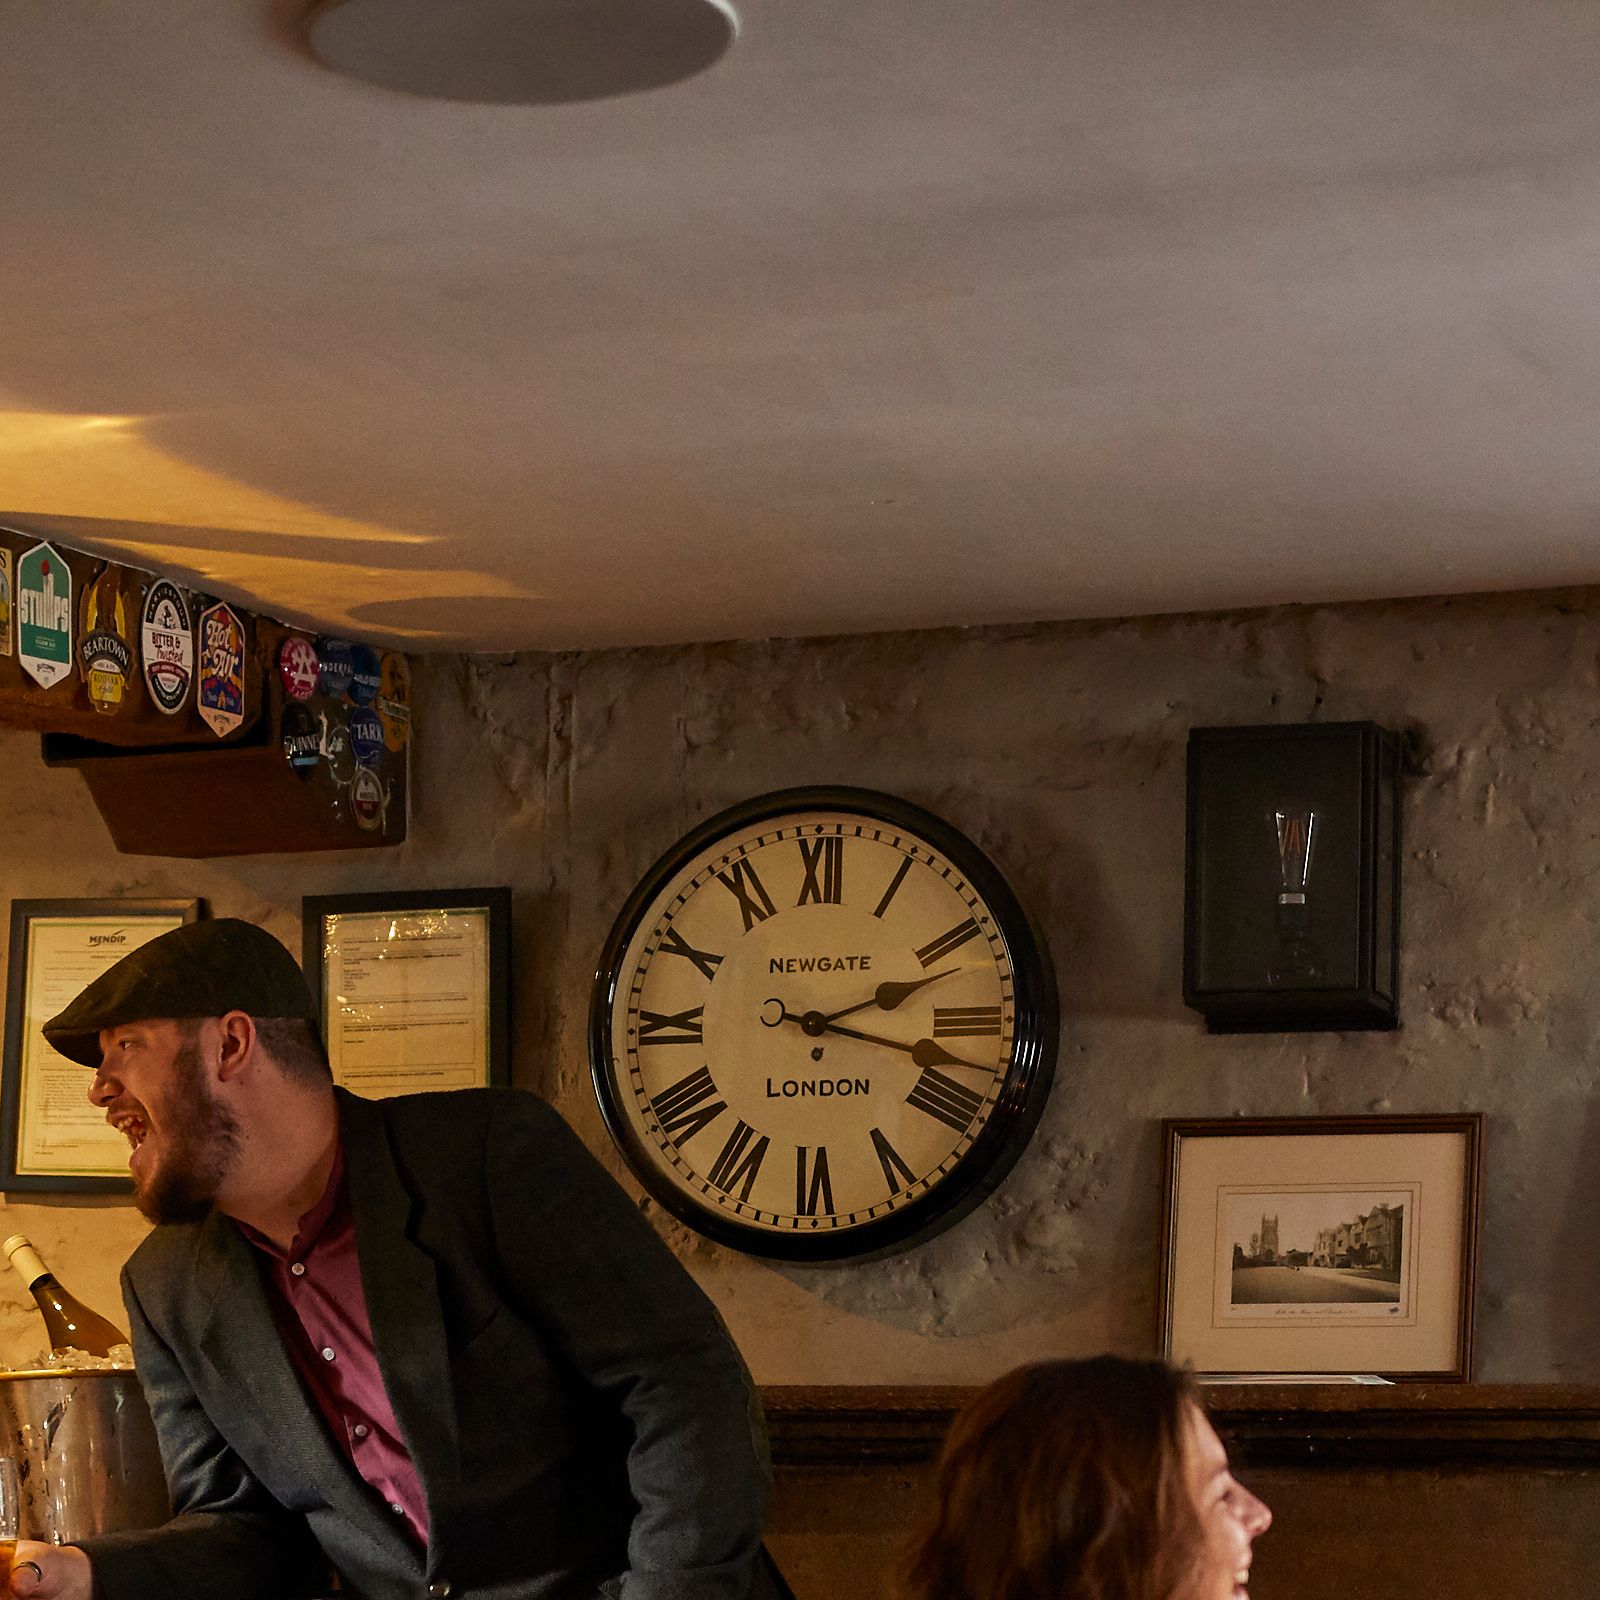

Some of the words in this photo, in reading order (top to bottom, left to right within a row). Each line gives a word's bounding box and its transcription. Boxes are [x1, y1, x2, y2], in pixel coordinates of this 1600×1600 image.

[152, 632, 174, 648] BITTER
[206, 619, 232, 650] Hot
[83, 637, 129, 666] BEARTOWN
[212, 649, 239, 683] Air
[796, 836, 844, 907] XII
[89, 935, 126, 944] MENDIP
[769, 956, 872, 974] NEWGATE
[766, 1077, 870, 1099] LONDON
